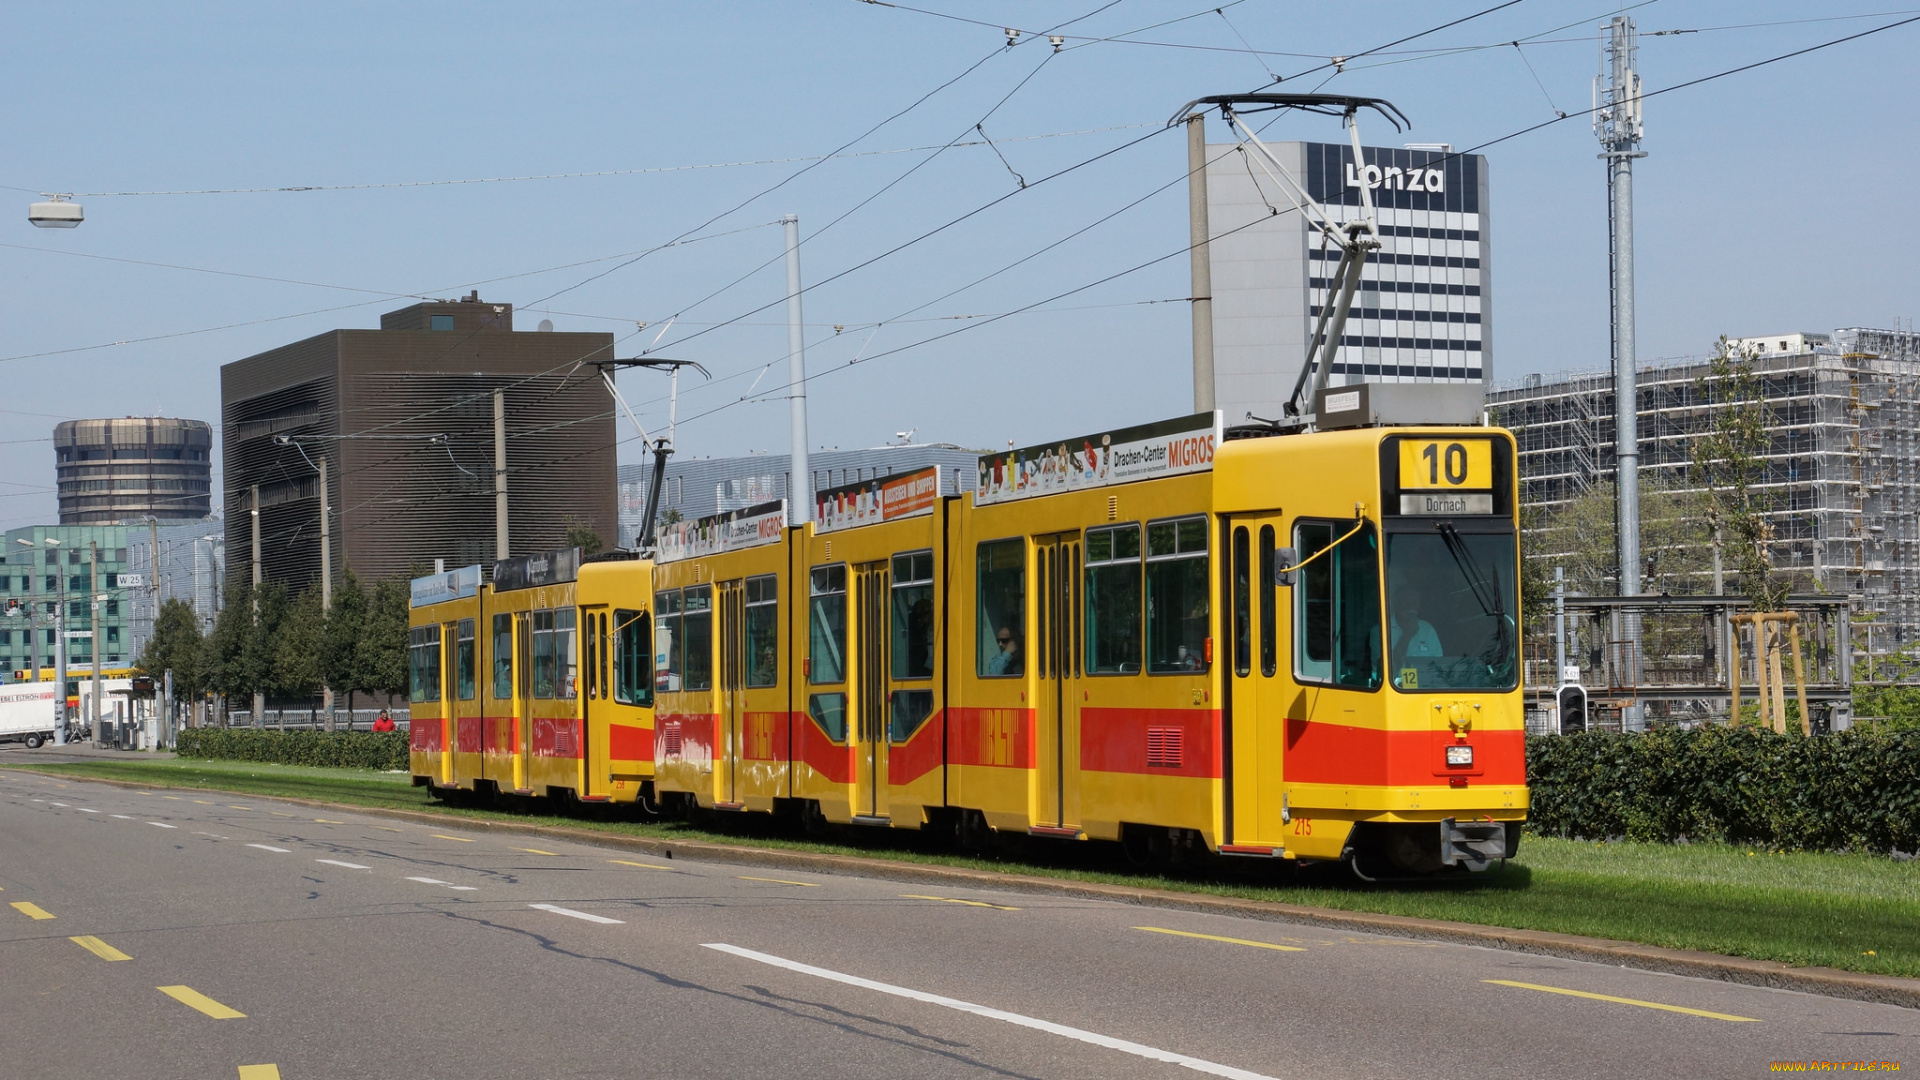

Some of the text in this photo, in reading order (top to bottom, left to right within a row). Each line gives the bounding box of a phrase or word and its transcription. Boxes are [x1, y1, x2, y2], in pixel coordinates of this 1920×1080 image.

[1346, 163, 1444, 193] Lonza
[1114, 445, 1167, 467] Drachen-Center
[1168, 434, 1214, 469] MIGROS
[1423, 442, 1468, 486] 10
[1426, 498, 1467, 512] Dornach
[758, 514, 782, 539] MIGROS
[119, 575, 140, 584] W 25
[1403, 671, 1416, 684] 12
[1564, 668, 1570, 678] K
[1294, 818, 1312, 836] 215
